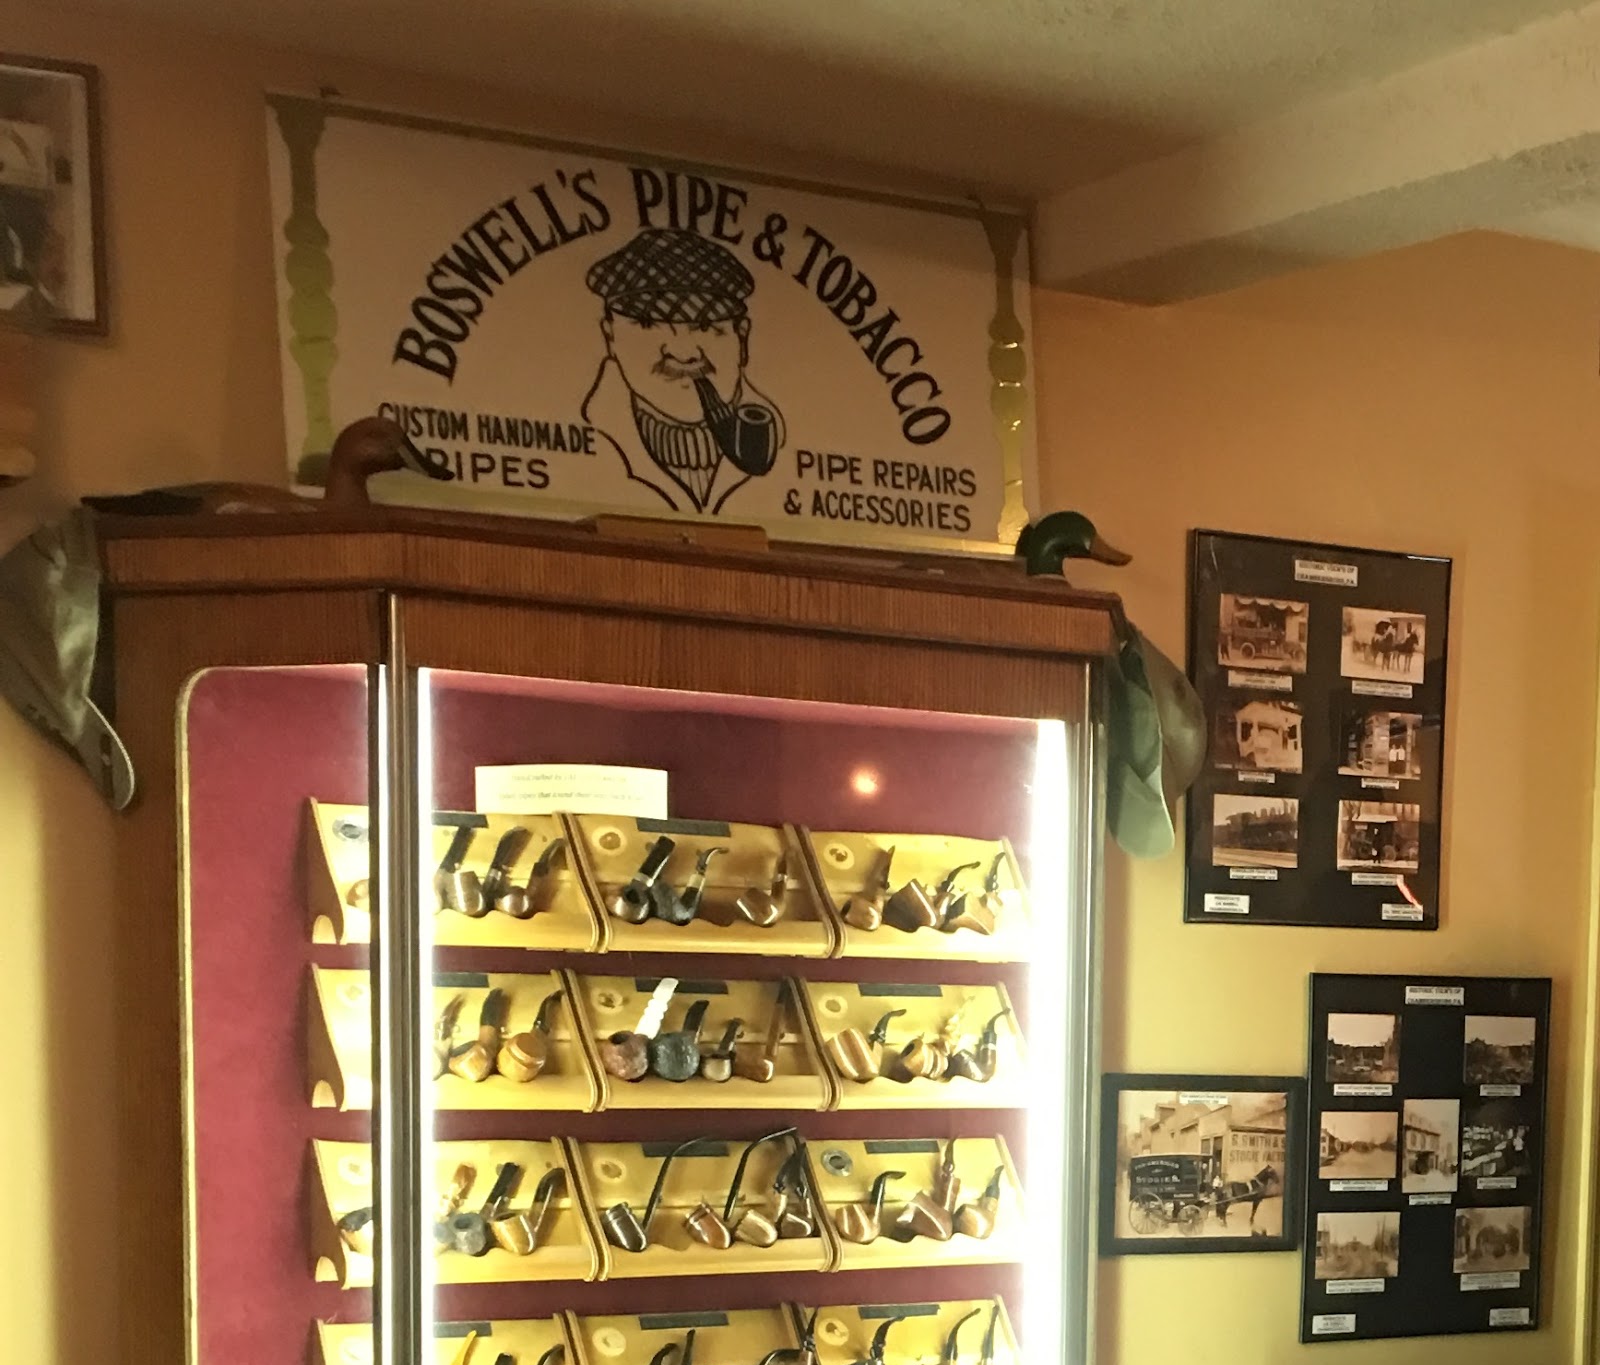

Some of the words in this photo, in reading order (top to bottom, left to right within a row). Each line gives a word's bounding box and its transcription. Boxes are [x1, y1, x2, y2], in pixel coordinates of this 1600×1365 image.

[392, 168, 611, 387] BOSWELL'S
[630, 167, 748, 245] PIPE
[752, 213, 788, 270] &
[792, 225, 951, 446] TOBACCO
[378, 402, 469, 442] CUSTOM
[476, 413, 597, 456] HANDMADE
[423, 447, 550, 489] PIPES
[796, 449, 862, 486] PIPE
[873, 459, 977, 497] REPAIRS
[783, 488, 802, 516] &
[811, 489, 972, 532] ACCESSORIES
